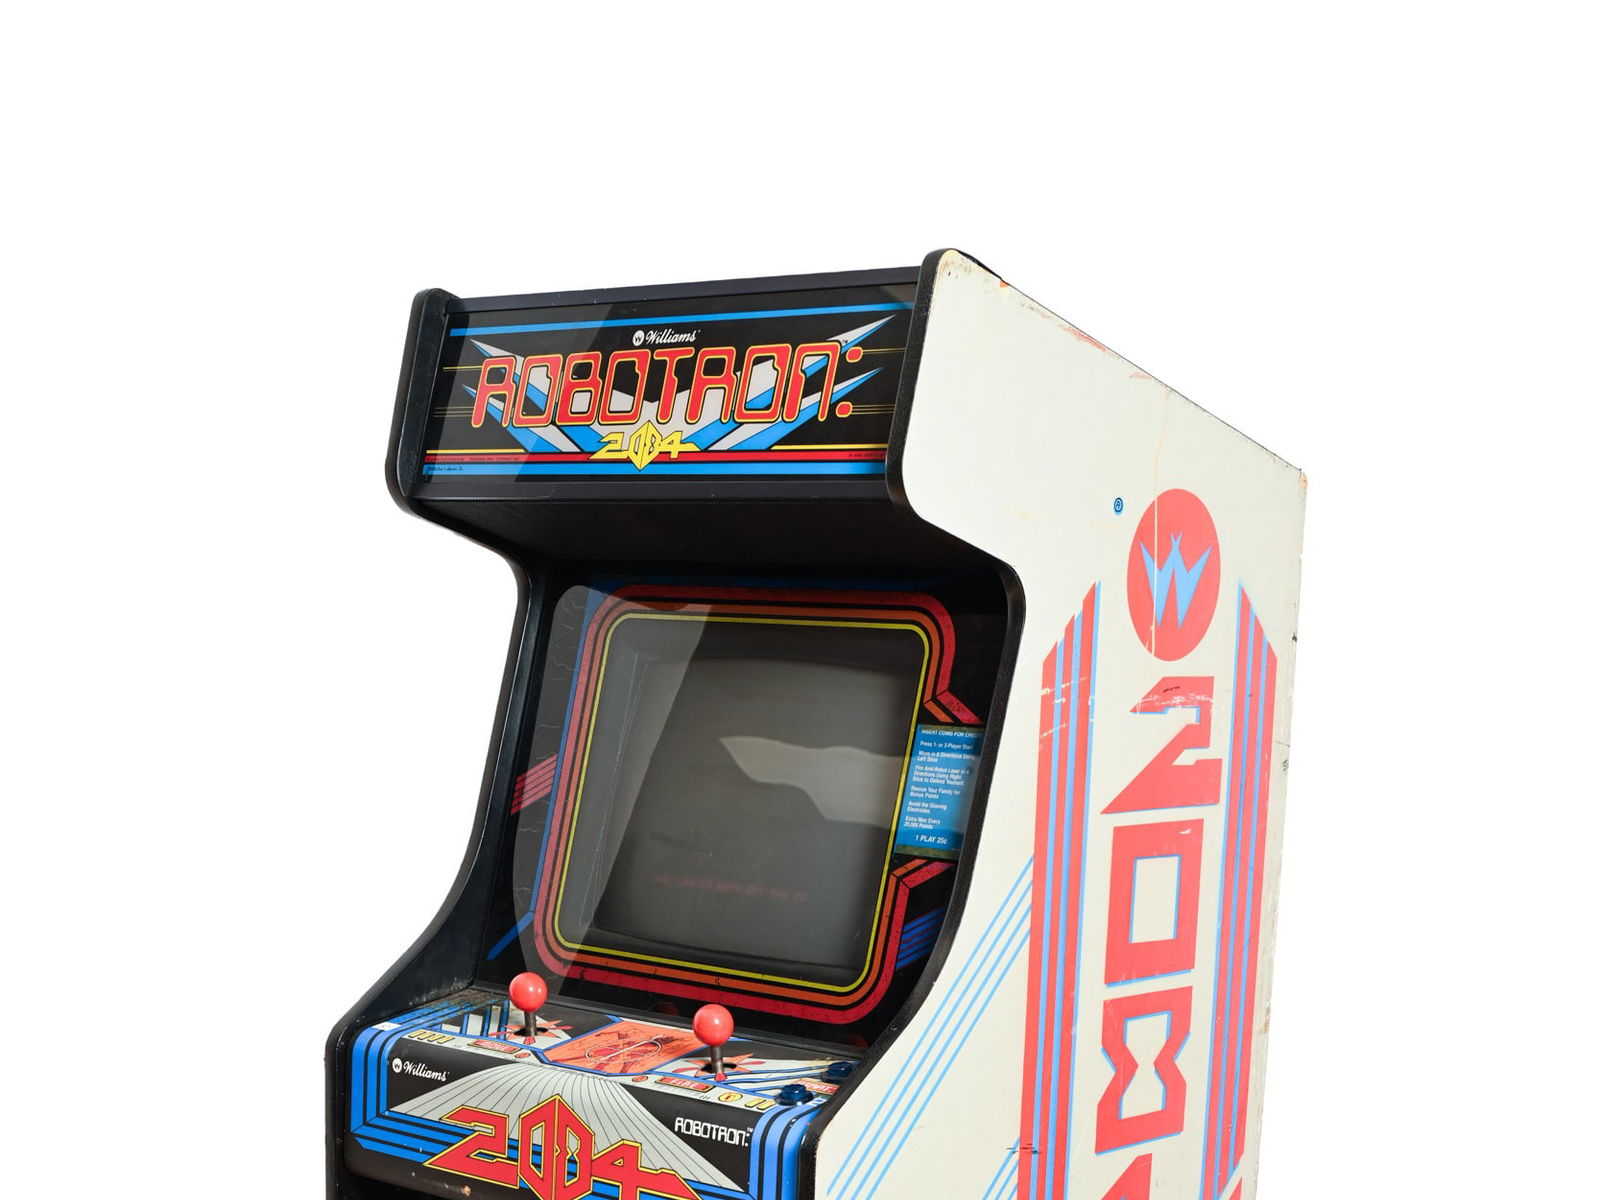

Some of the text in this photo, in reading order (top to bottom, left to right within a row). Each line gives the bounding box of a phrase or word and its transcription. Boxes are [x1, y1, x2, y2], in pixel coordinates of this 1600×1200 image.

[646, 328, 697, 345] Williams
[588, 420, 702, 471] 2084
[920, 835, 937, 843] PLAY
[403, 1061, 448, 1082] Williams
